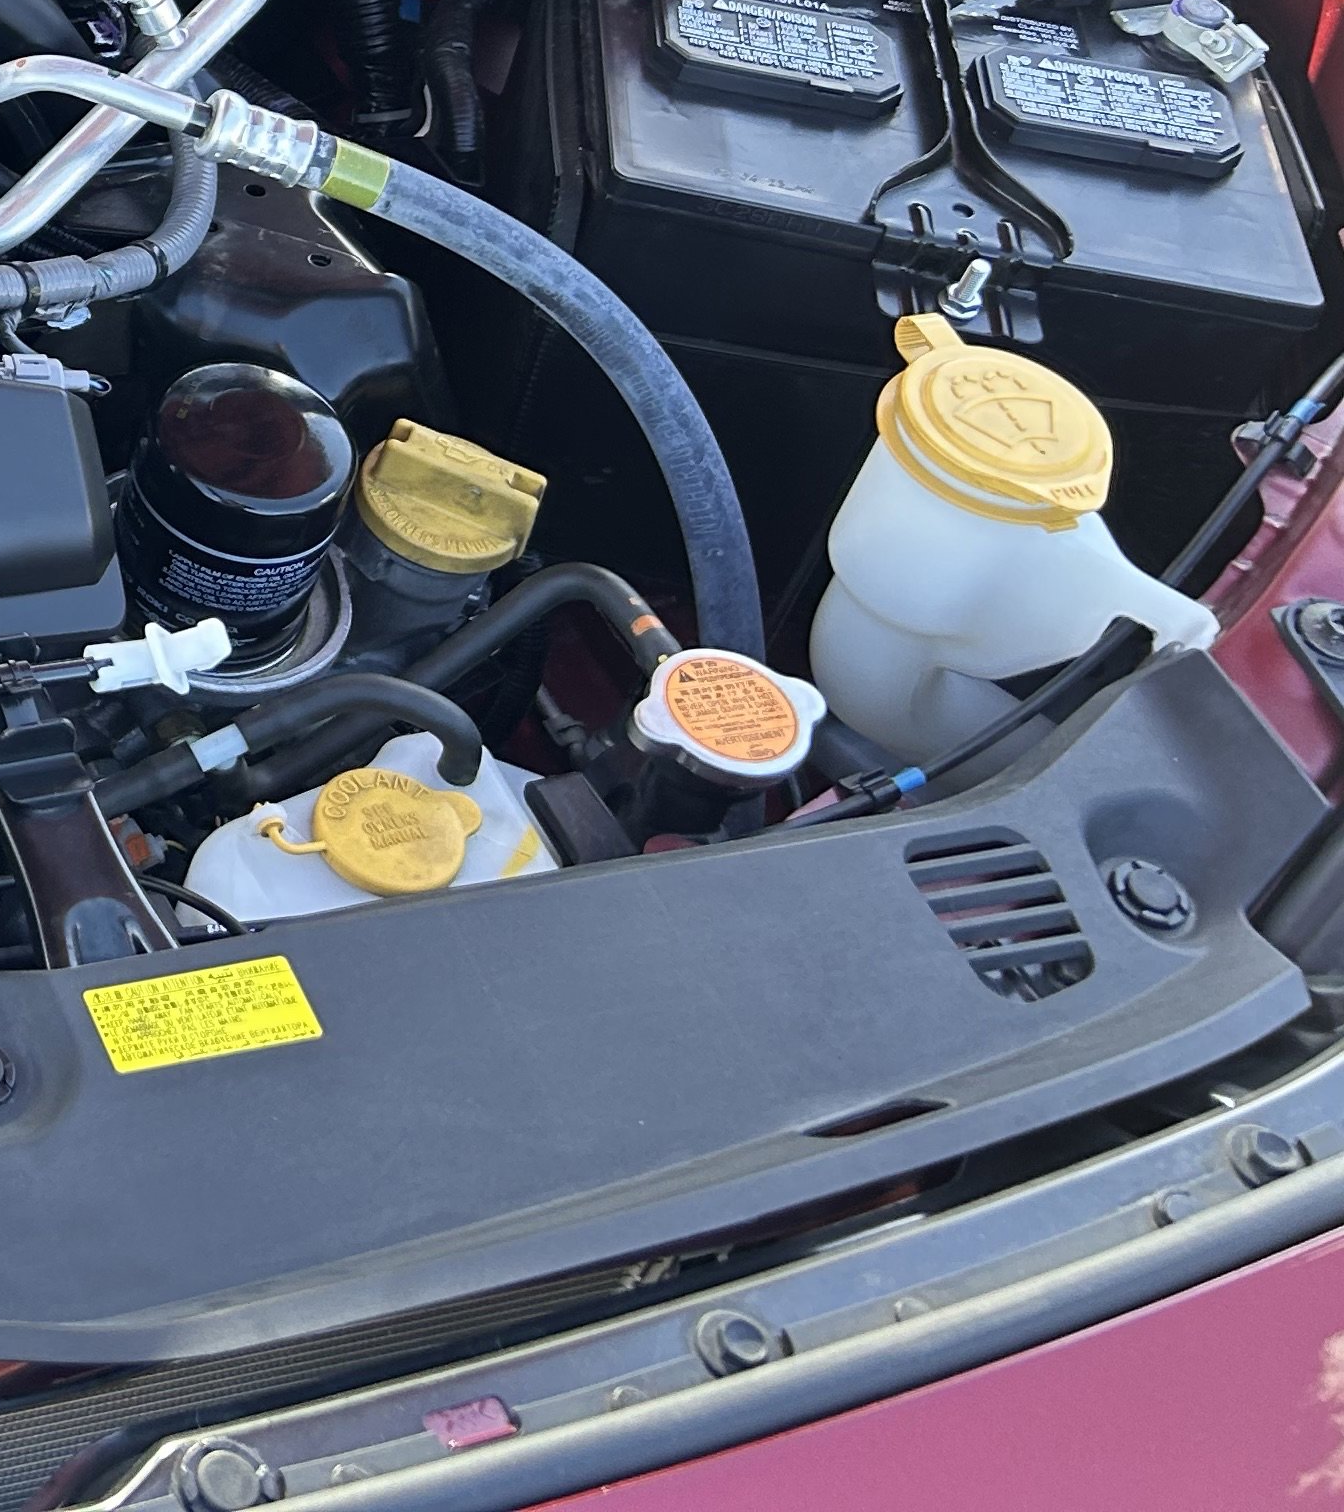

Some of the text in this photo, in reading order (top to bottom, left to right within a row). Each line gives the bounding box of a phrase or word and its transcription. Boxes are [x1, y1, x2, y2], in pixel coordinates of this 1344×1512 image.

[728, 0, 818, 27] DANGER/POISON
[1053, 60, 1151, 86] DANGER/POISON
[253, 560, 305, 577] CAUTION
[323, 771, 430, 819] COOLANT
[125, 982, 160, 996] CAUTION
[162, 974, 205, 991] ATTENTION
